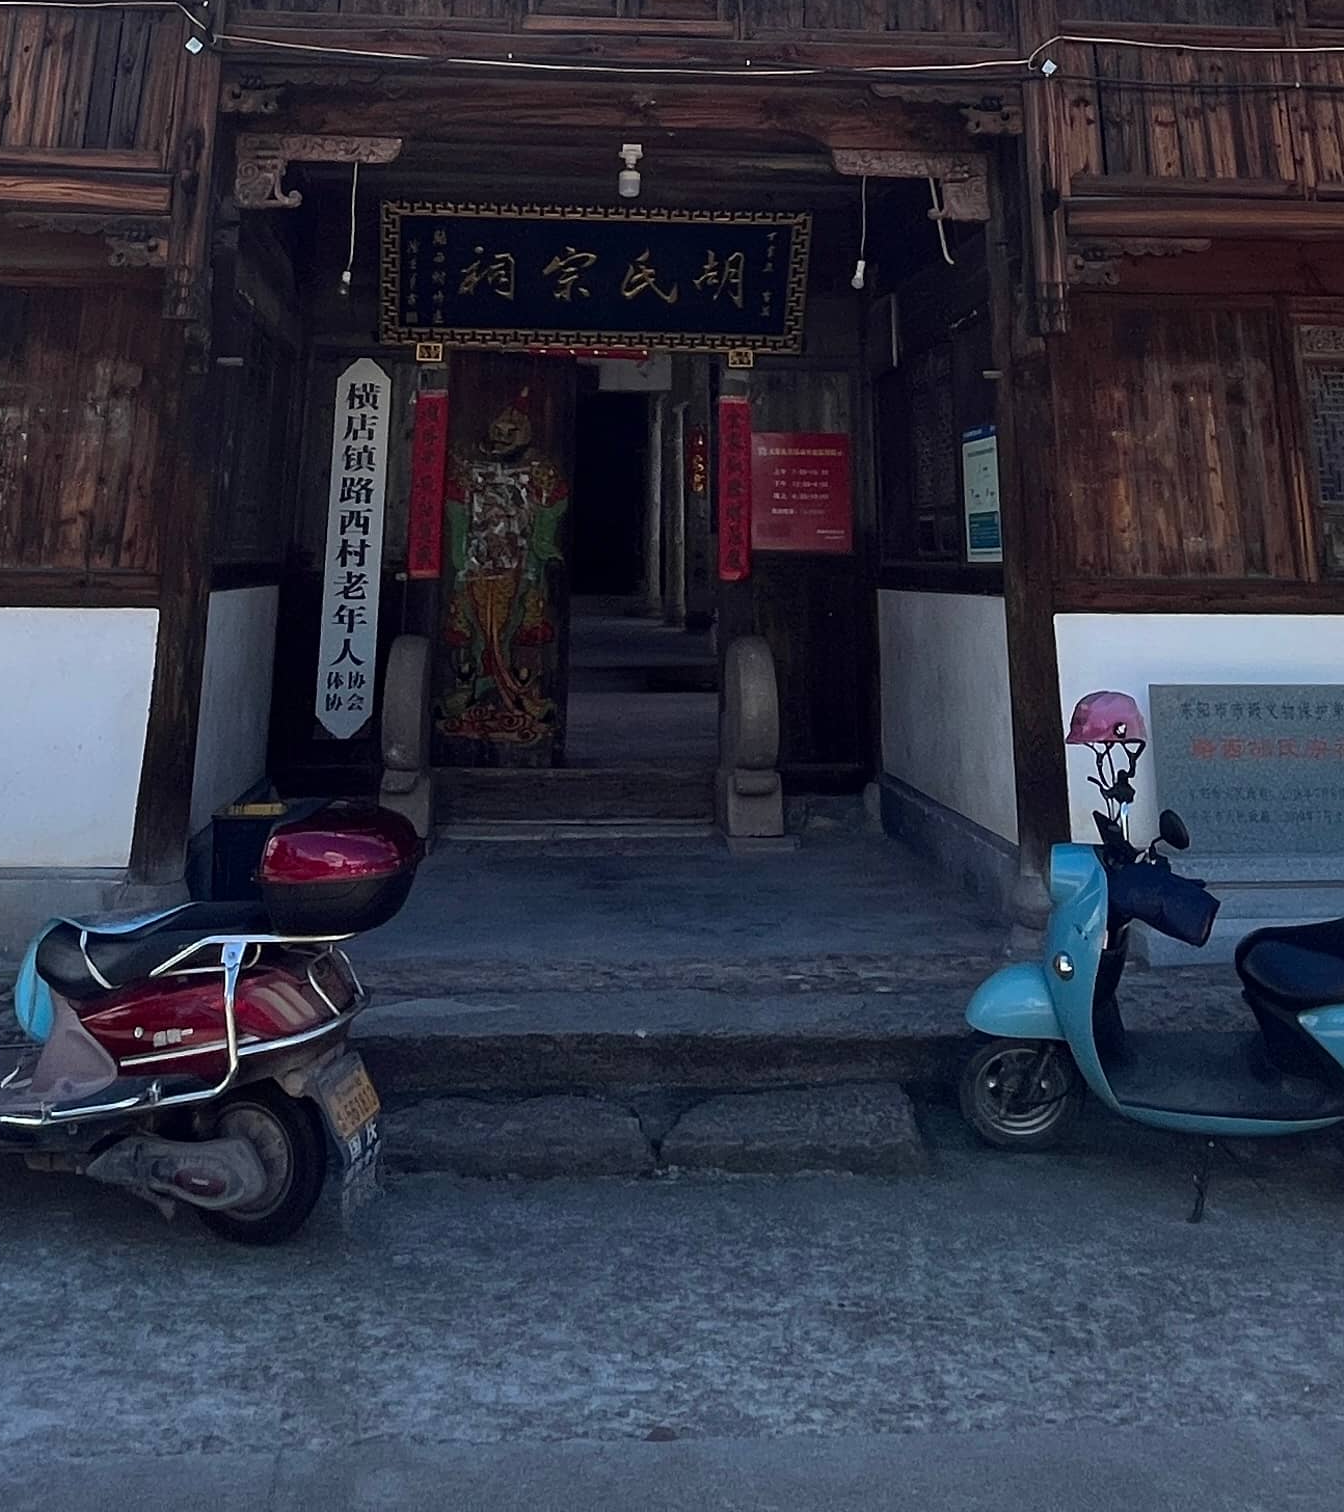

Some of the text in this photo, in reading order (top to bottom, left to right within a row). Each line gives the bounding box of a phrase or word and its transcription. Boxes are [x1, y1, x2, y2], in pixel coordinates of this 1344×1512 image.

[456, 244, 747, 310] 胡氏宗祠
[330, 381, 382, 668] 横店镇路西村老年人
[346, 671, 366, 711] 协会
